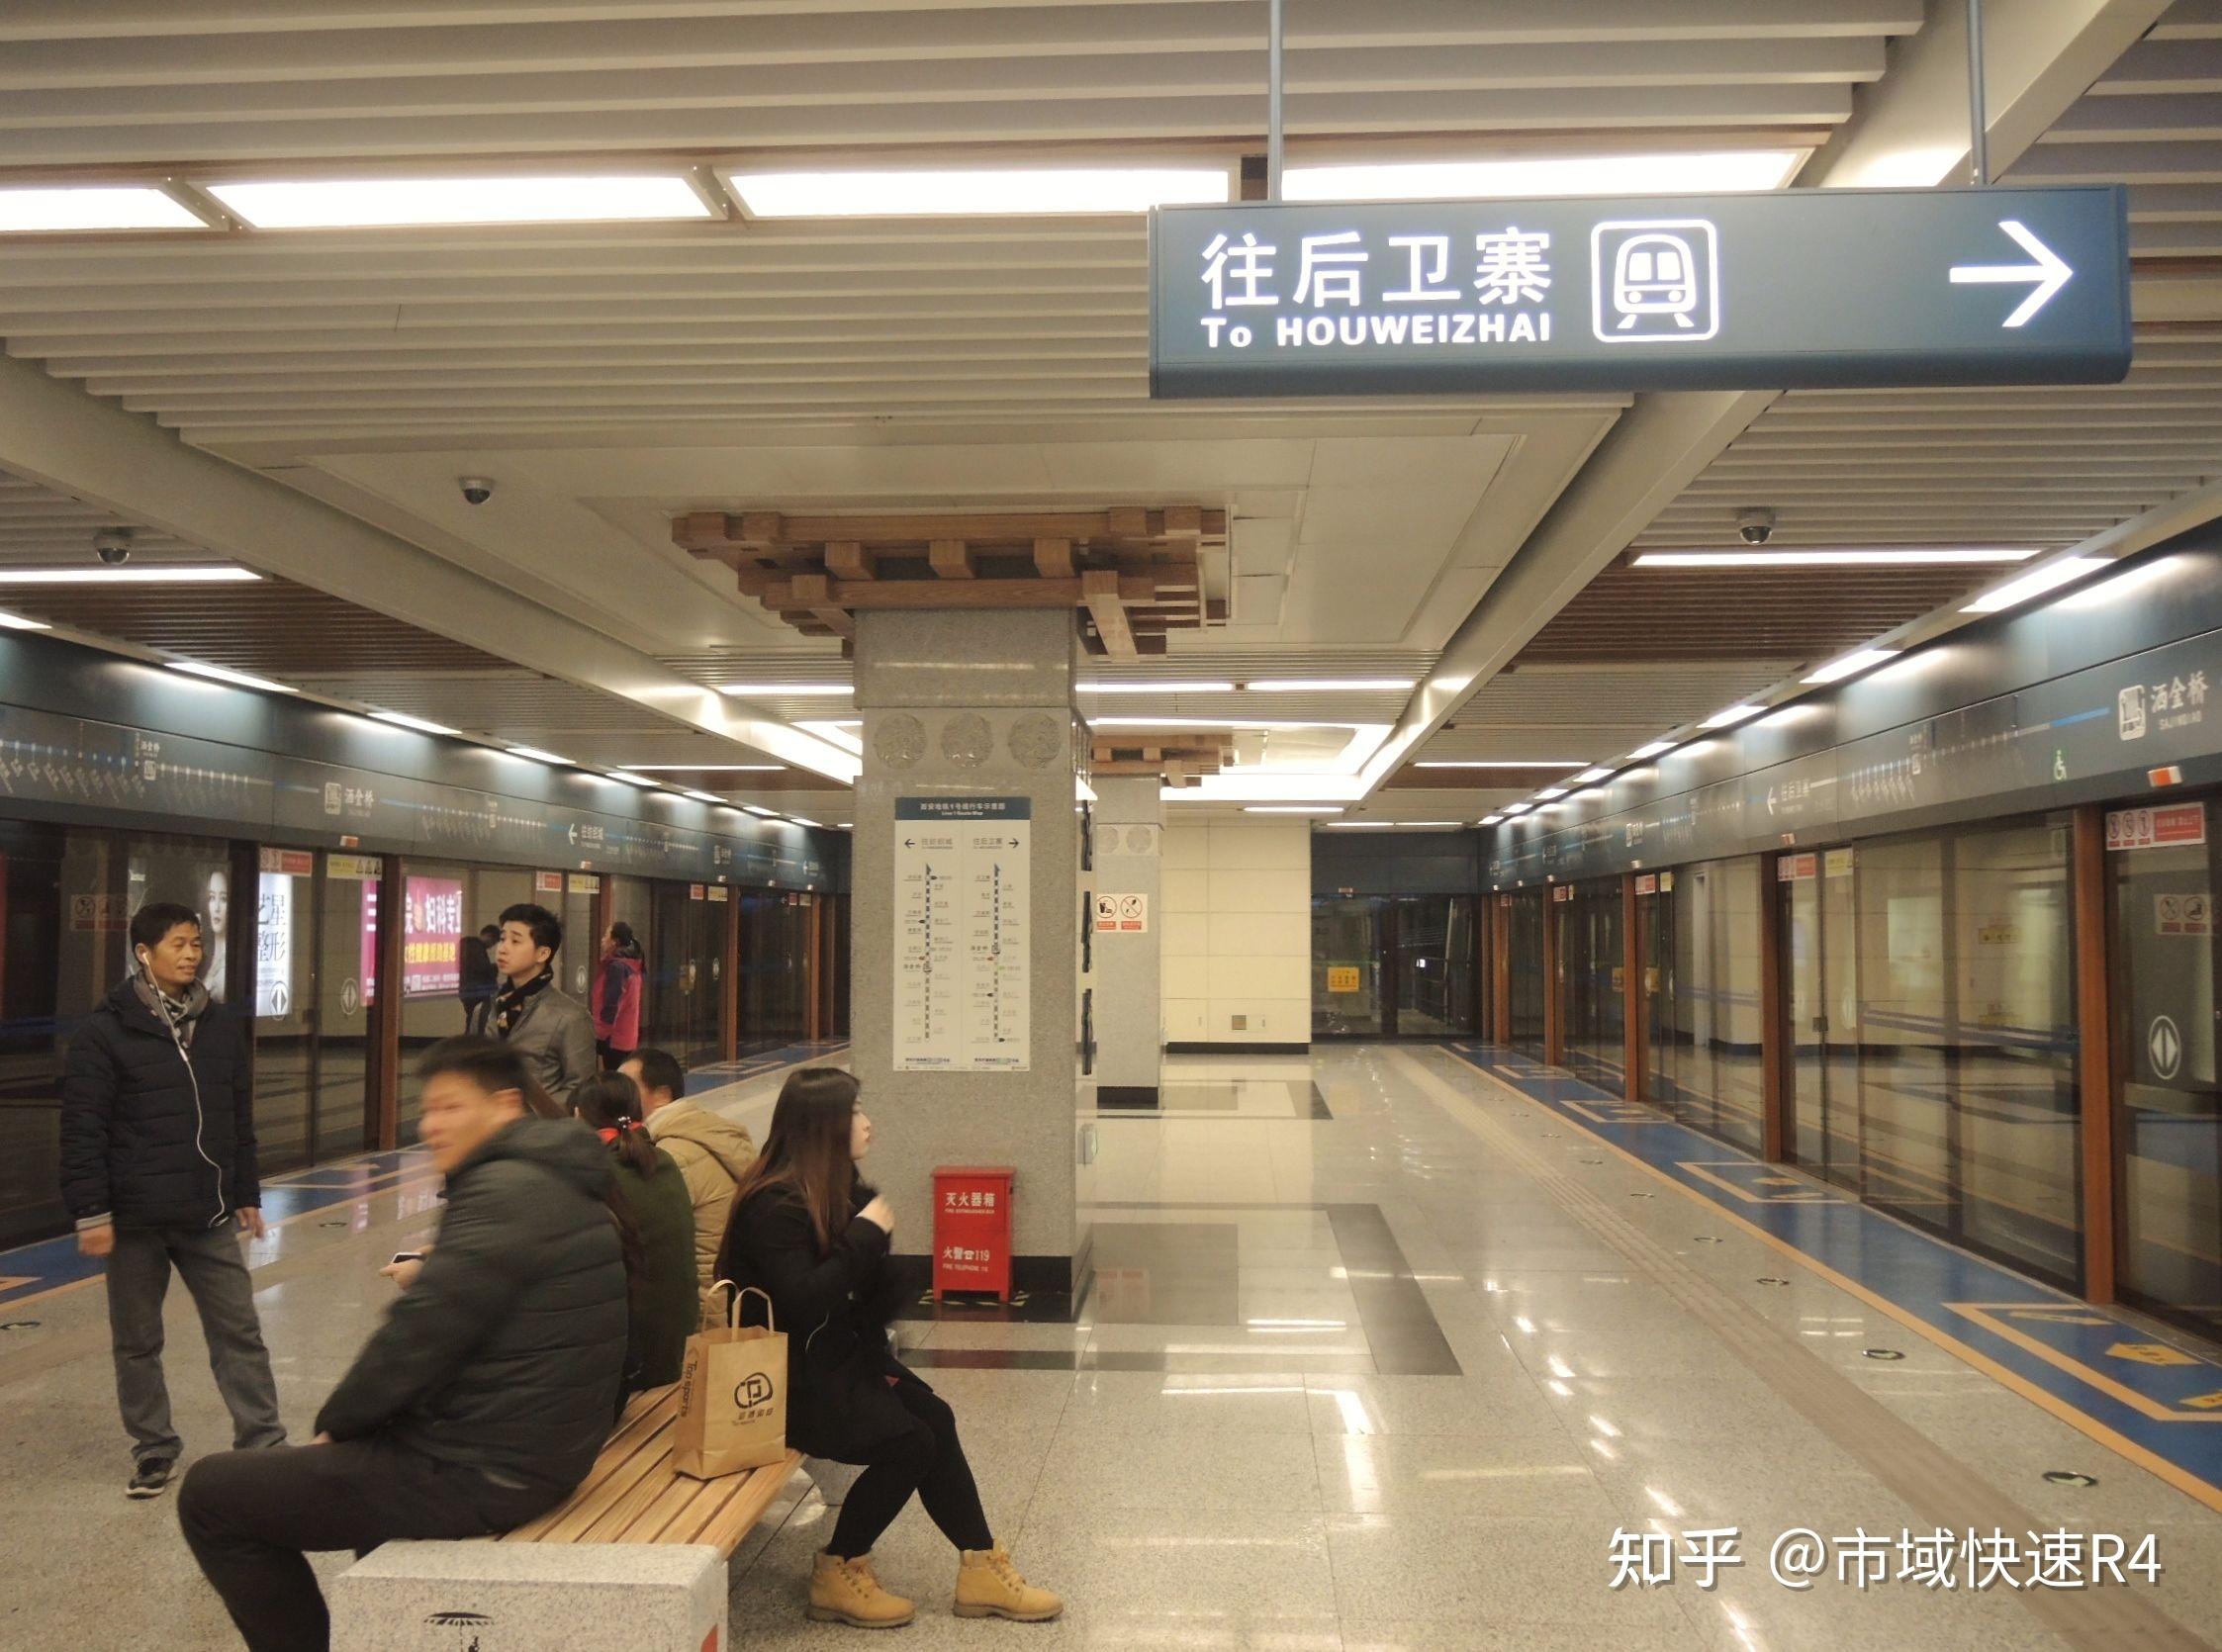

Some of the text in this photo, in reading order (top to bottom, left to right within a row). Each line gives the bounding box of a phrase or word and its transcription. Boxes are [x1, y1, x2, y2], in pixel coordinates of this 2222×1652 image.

[1200, 227, 1552, 310] 往后卫寨
[1200, 312, 1551, 349] To HOUWEIZHAI
[945, 1192, 995, 1207] 灭火器箱
